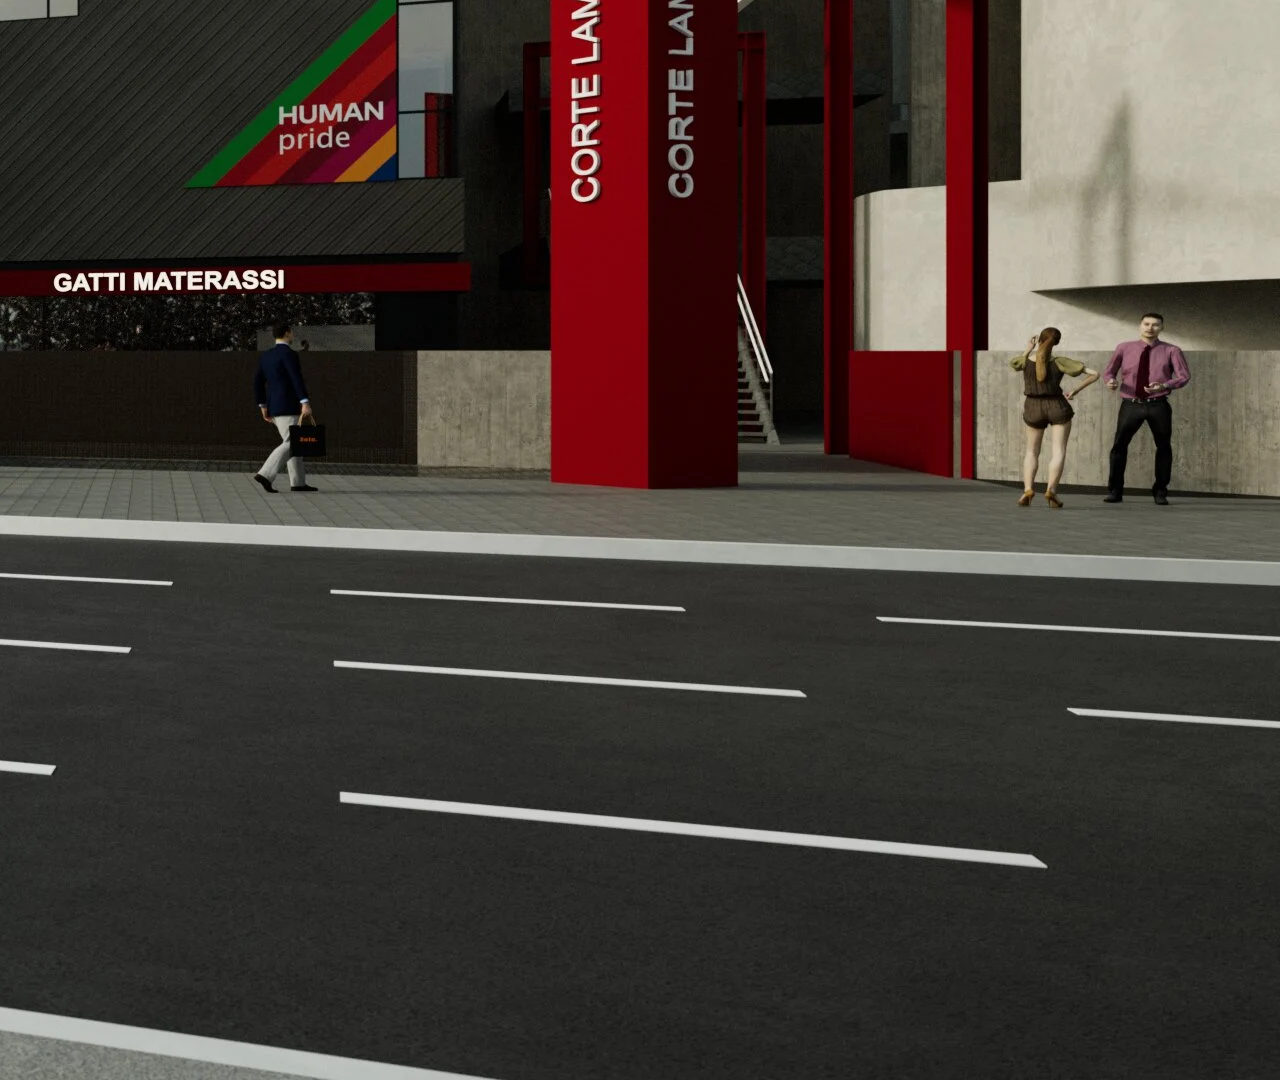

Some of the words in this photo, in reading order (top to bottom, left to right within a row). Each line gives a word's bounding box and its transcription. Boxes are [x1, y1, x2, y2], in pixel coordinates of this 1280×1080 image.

[278, 101, 384, 125] HUMAN
[279, 126, 351, 155] pride
[570, 73, 601, 204] CORTE
[668, 68, 694, 199] CORTE
[53, 272, 125, 292] GATTI
[133, 270, 284, 291] MATERASSI
